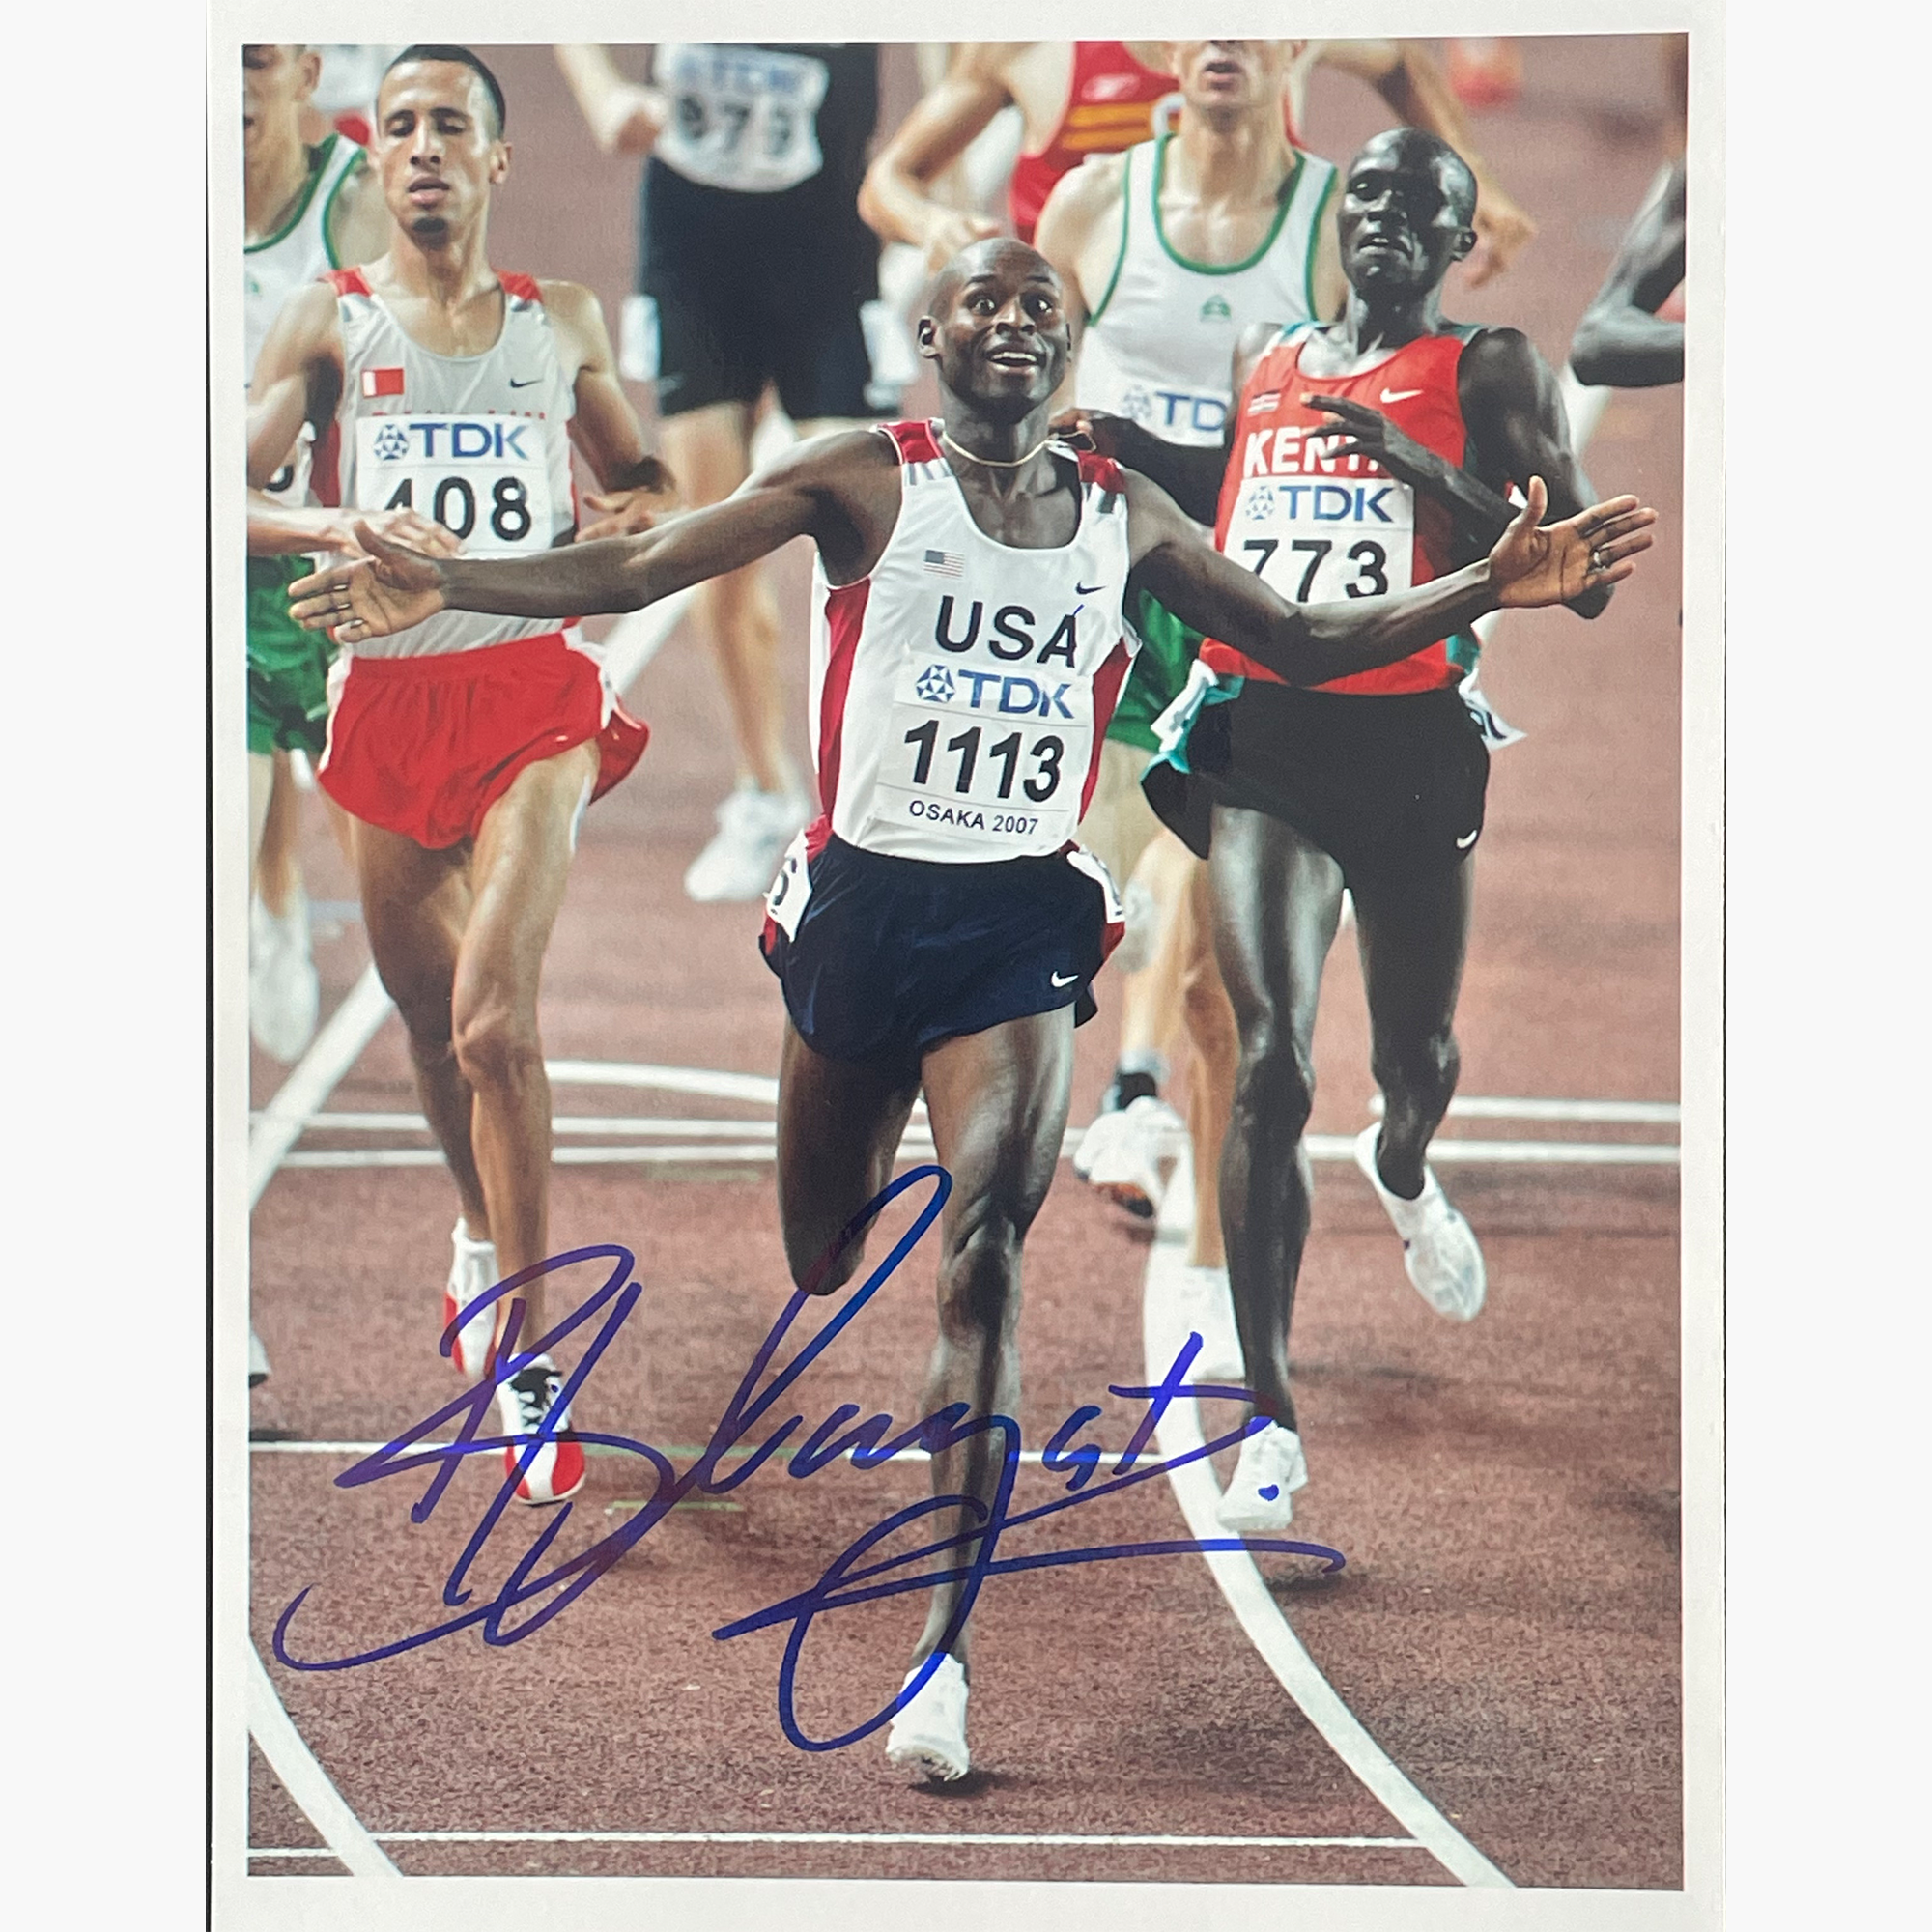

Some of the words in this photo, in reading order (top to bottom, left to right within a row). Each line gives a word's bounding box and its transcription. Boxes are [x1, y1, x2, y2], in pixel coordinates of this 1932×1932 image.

[1154, 390, 1228, 432] TD
[409, 423, 529, 461] TDK
[1243, 426, 1379, 479] KEN
[1278, 485, 1396, 523] TDK
[1243, 538, 1389, 603] 773
[935, 595, 1077, 668] USA
[957, 668, 1075, 720] TDK
[904, 719, 1065, 803] 1113
[909, 800, 985, 831] OSAKA
[992, 815, 1039, 835] 2007
